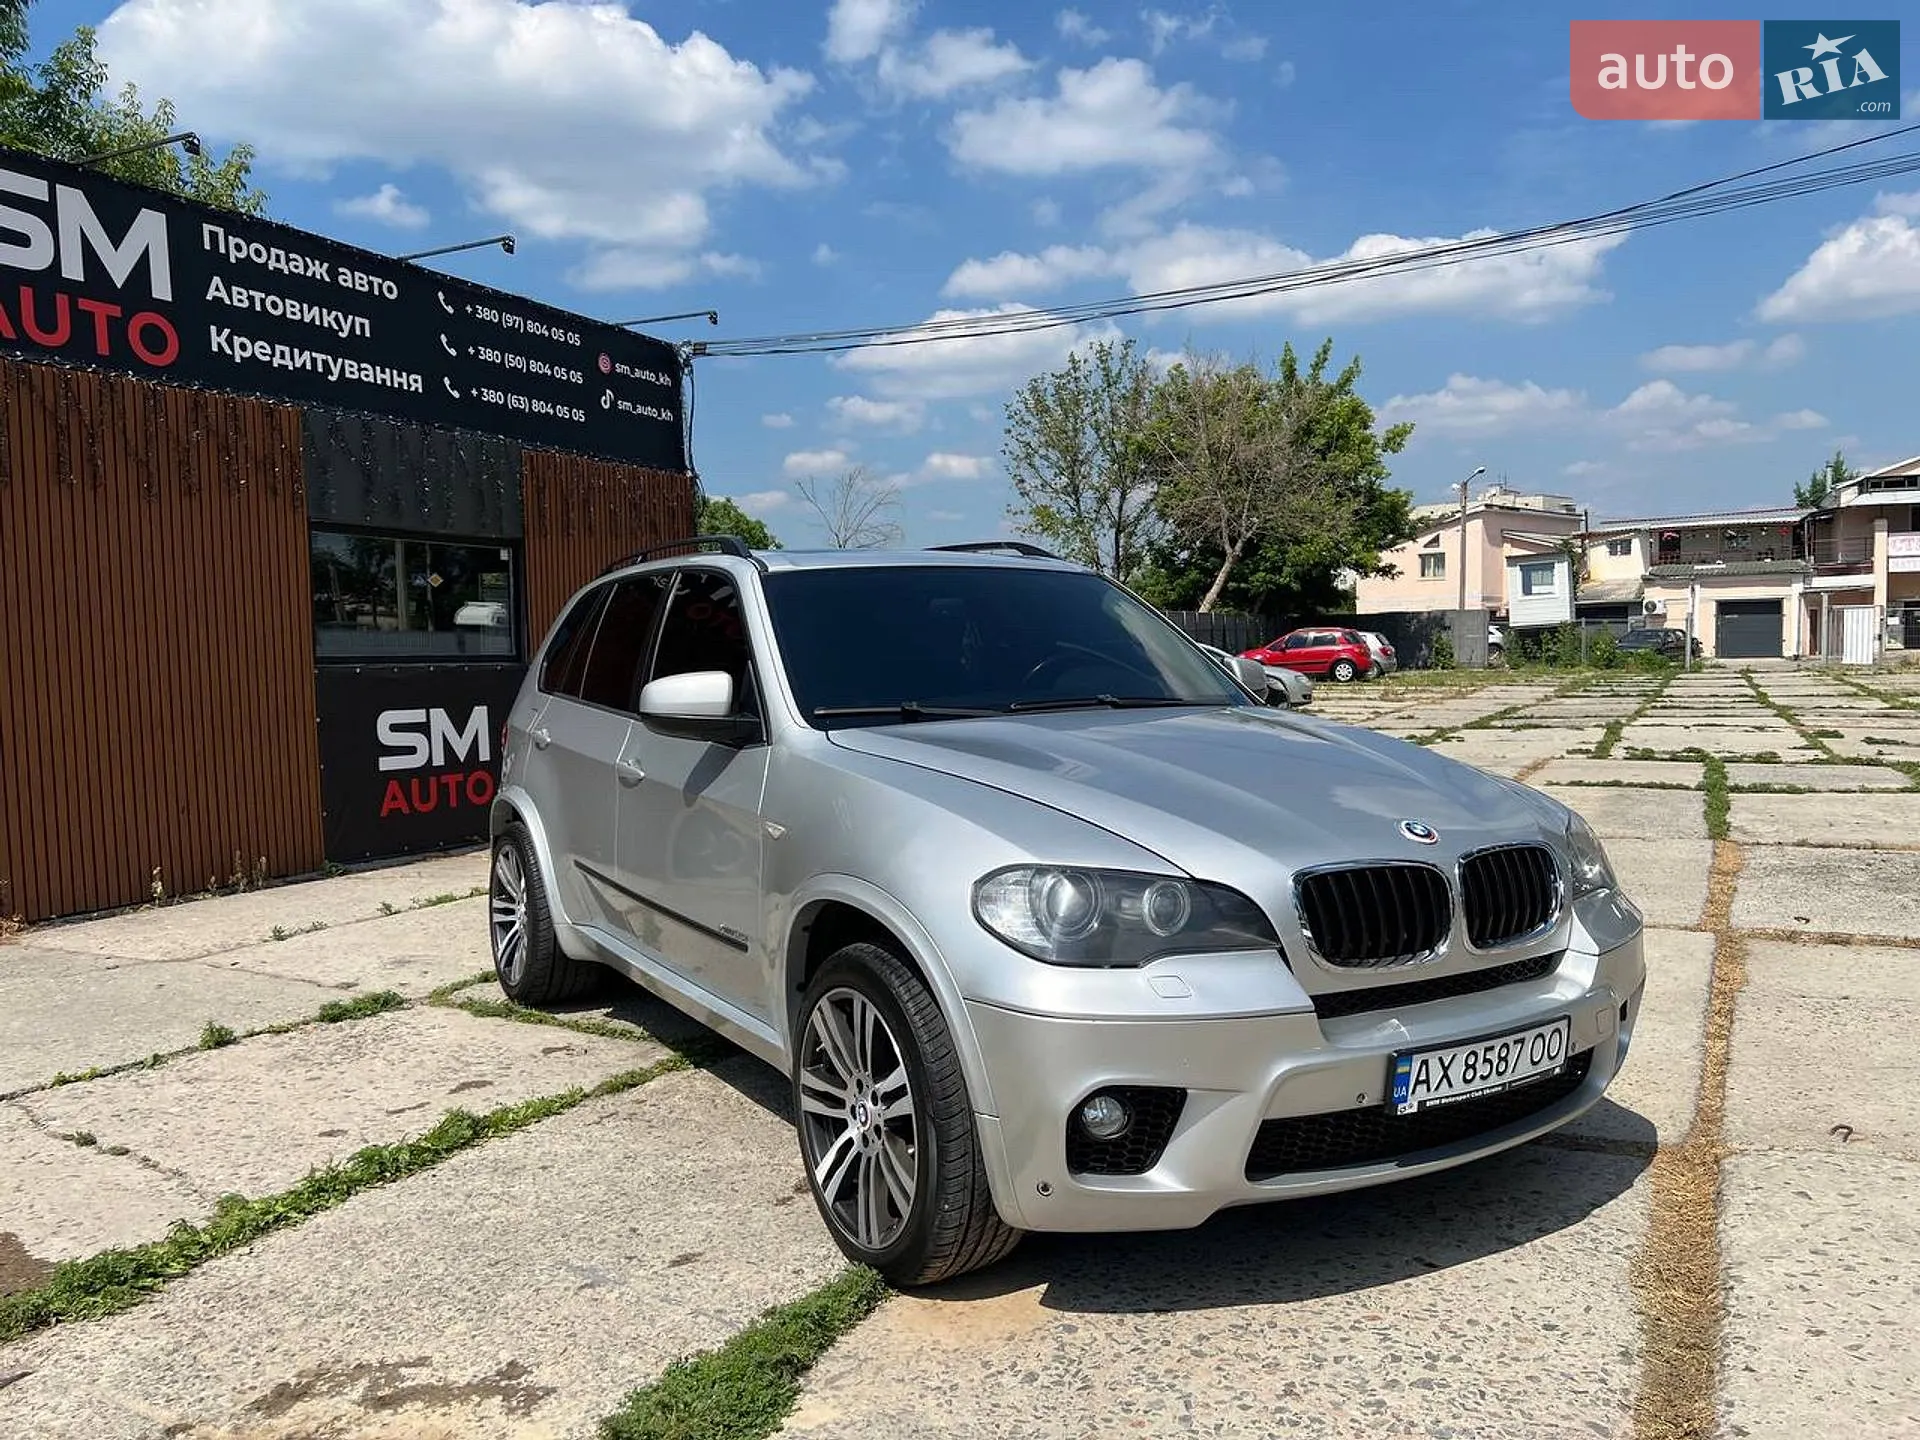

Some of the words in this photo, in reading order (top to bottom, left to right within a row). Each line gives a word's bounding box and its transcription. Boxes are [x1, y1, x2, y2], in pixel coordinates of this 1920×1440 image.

[202, 223, 331, 282] Продаж
[337, 266, 399, 300] авто
[0, 284, 180, 367] UTO
[205, 275, 371, 338] Автовикуп
[502, 311, 524, 334] (97)
[526, 320, 549, 337] 804
[551, 326, 565, 342] 05
[567, 331, 581, 346] 05
[209, 324, 424, 394] Кредитування
[504, 352, 527, 373] (50)
[529, 359, 552, 376] 804
[553, 366, 568, 380] 05
[569, 370, 583, 384] 05
[615, 362, 672, 388] sm_auto_kh
[507, 392, 529, 413] (63)
[531, 399, 554, 415] 804
[556, 404, 570, 419] 05
[571, 408, 586, 422] 05
[616, 400, 673, 422] sm_auto_kh
[376, 705, 491, 771] SM
[380, 770, 495, 817] AUTO
[1410, 1052, 1457, 1096] AX
[1462, 1037, 1526, 1085] 8587
[1393, 1085, 1407, 1098] UA
